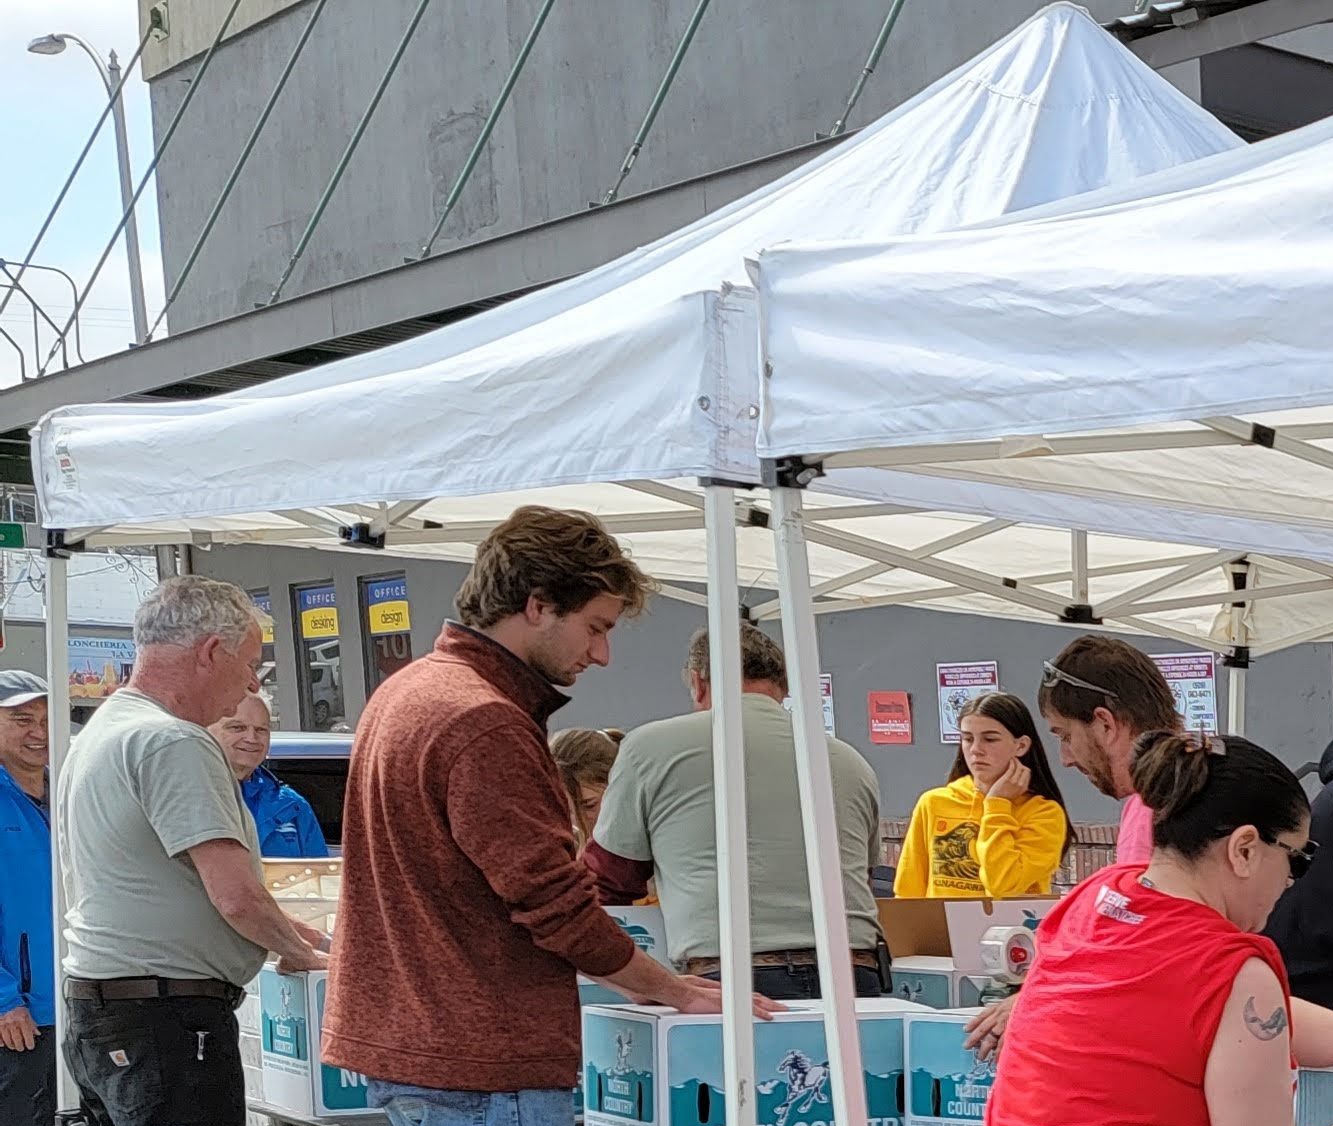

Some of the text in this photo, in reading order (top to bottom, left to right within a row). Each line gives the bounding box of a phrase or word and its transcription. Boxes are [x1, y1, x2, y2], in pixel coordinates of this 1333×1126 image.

[306, 593, 336, 605] OFFICE
[374, 585, 407, 599] OFFICE
[310, 614, 335, 631] desking
[380, 609, 403, 626] design
[947, 1100, 987, 1118] COUNT
